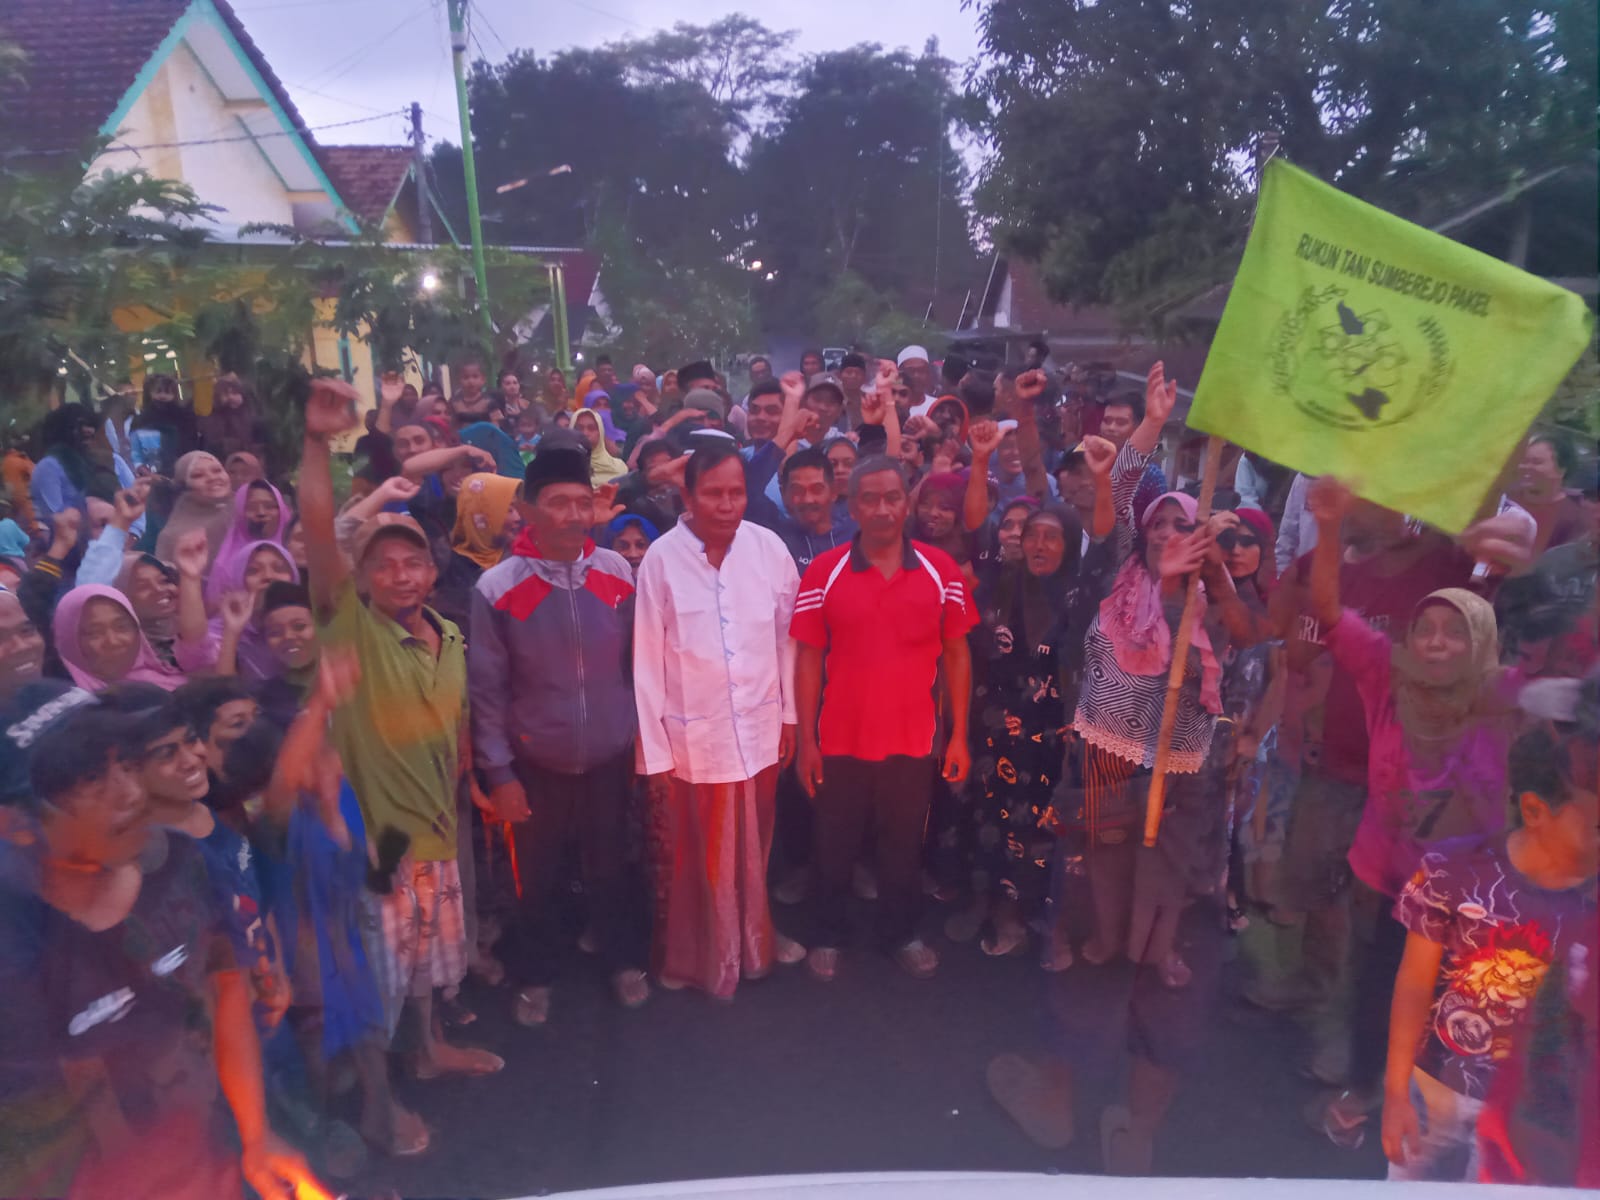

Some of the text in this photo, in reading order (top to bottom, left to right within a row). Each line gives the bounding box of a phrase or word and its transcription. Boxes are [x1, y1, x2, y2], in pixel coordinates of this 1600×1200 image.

[1296, 233, 1491, 317] RUKUN TANI SUMBEREJO PAKEL
